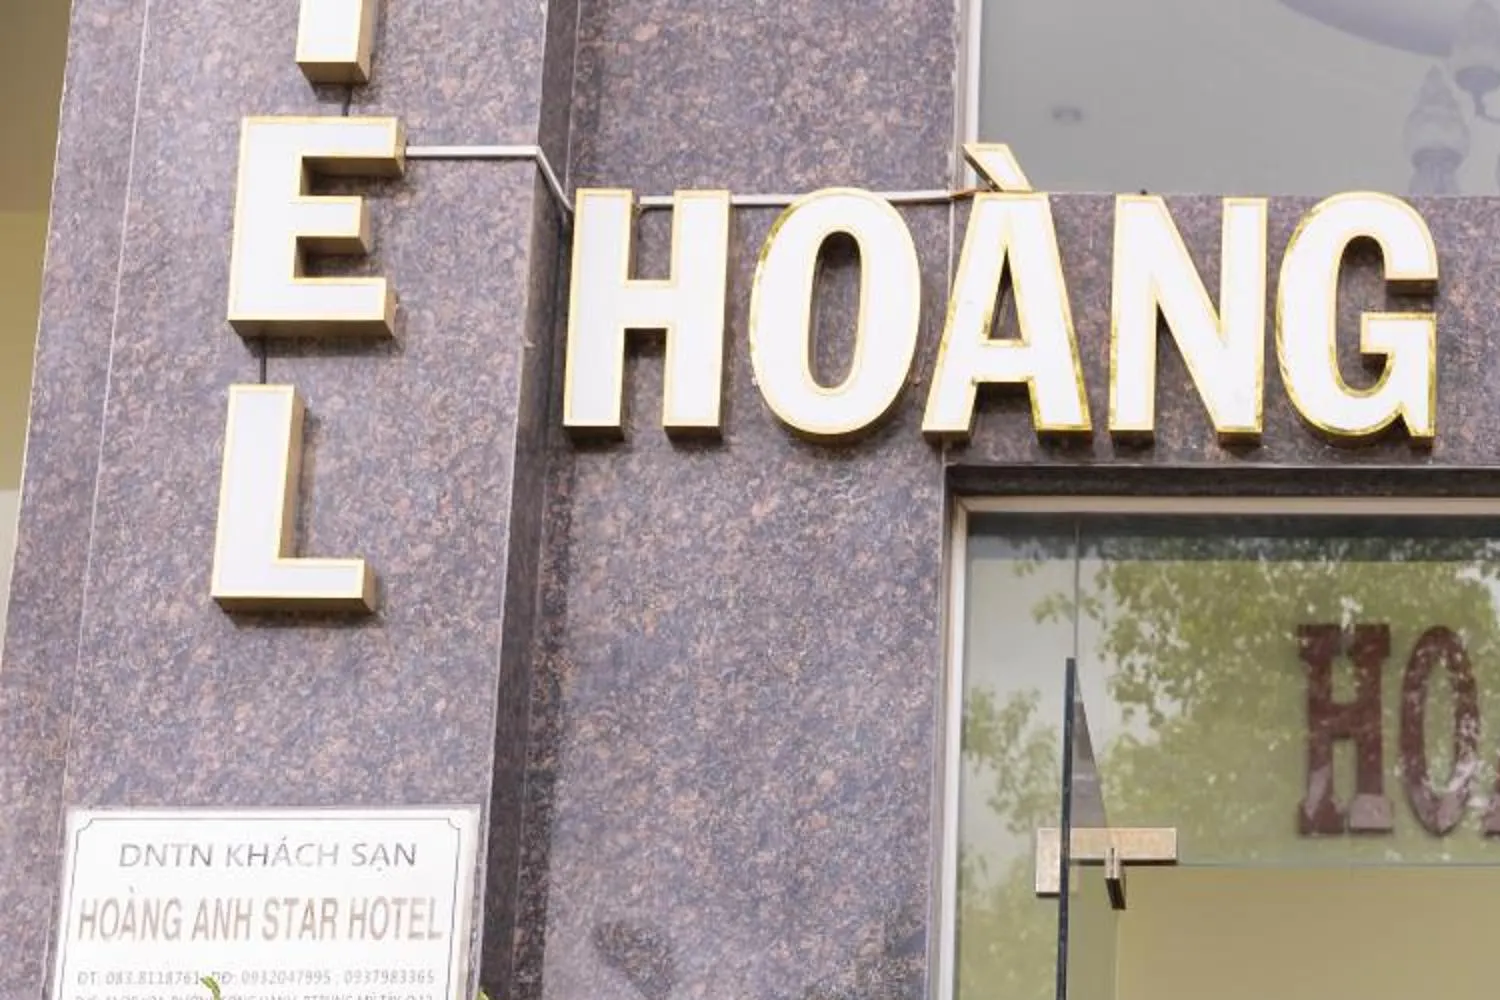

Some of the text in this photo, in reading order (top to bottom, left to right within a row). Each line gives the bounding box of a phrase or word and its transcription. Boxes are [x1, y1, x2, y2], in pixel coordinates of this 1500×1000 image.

[563, 143, 1440, 442] HOÀNG
[119, 836, 417, 872] DNTN KHÁCH SẠN
[78, 886, 444, 942] HOÀNG ANH STAR HOTEL
